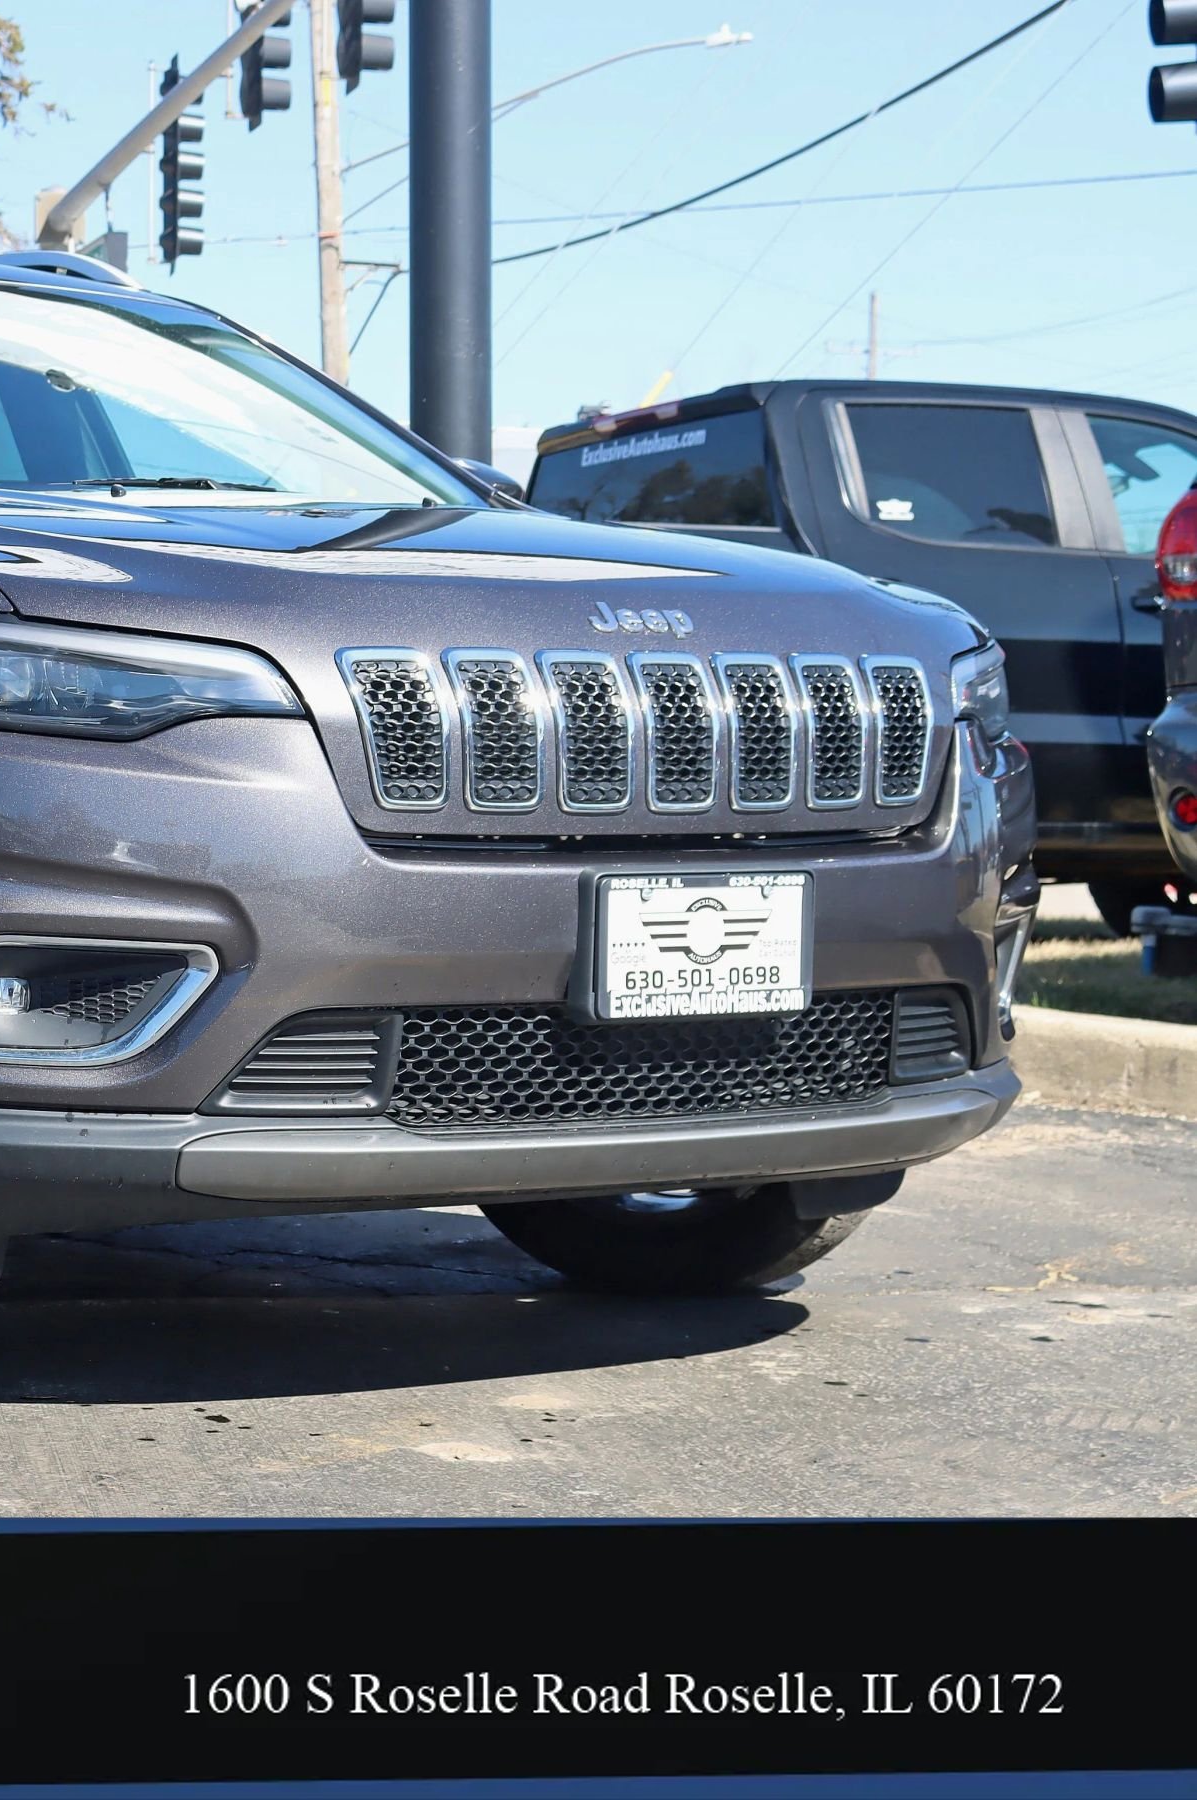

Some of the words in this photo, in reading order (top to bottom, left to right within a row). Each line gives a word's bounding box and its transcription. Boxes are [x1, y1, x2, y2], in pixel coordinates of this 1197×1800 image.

[580, 428, 707, 467] ExclusiveAutohaus.com
[587, 601, 694, 640] Jeep
[671, 877, 684, 888] IL
[688, 951, 722, 964] AUTOHAUS
[625, 966, 780, 990] 630-501-0698
[610, 986, 805, 1018] ExclusiveAutoHaus.com
